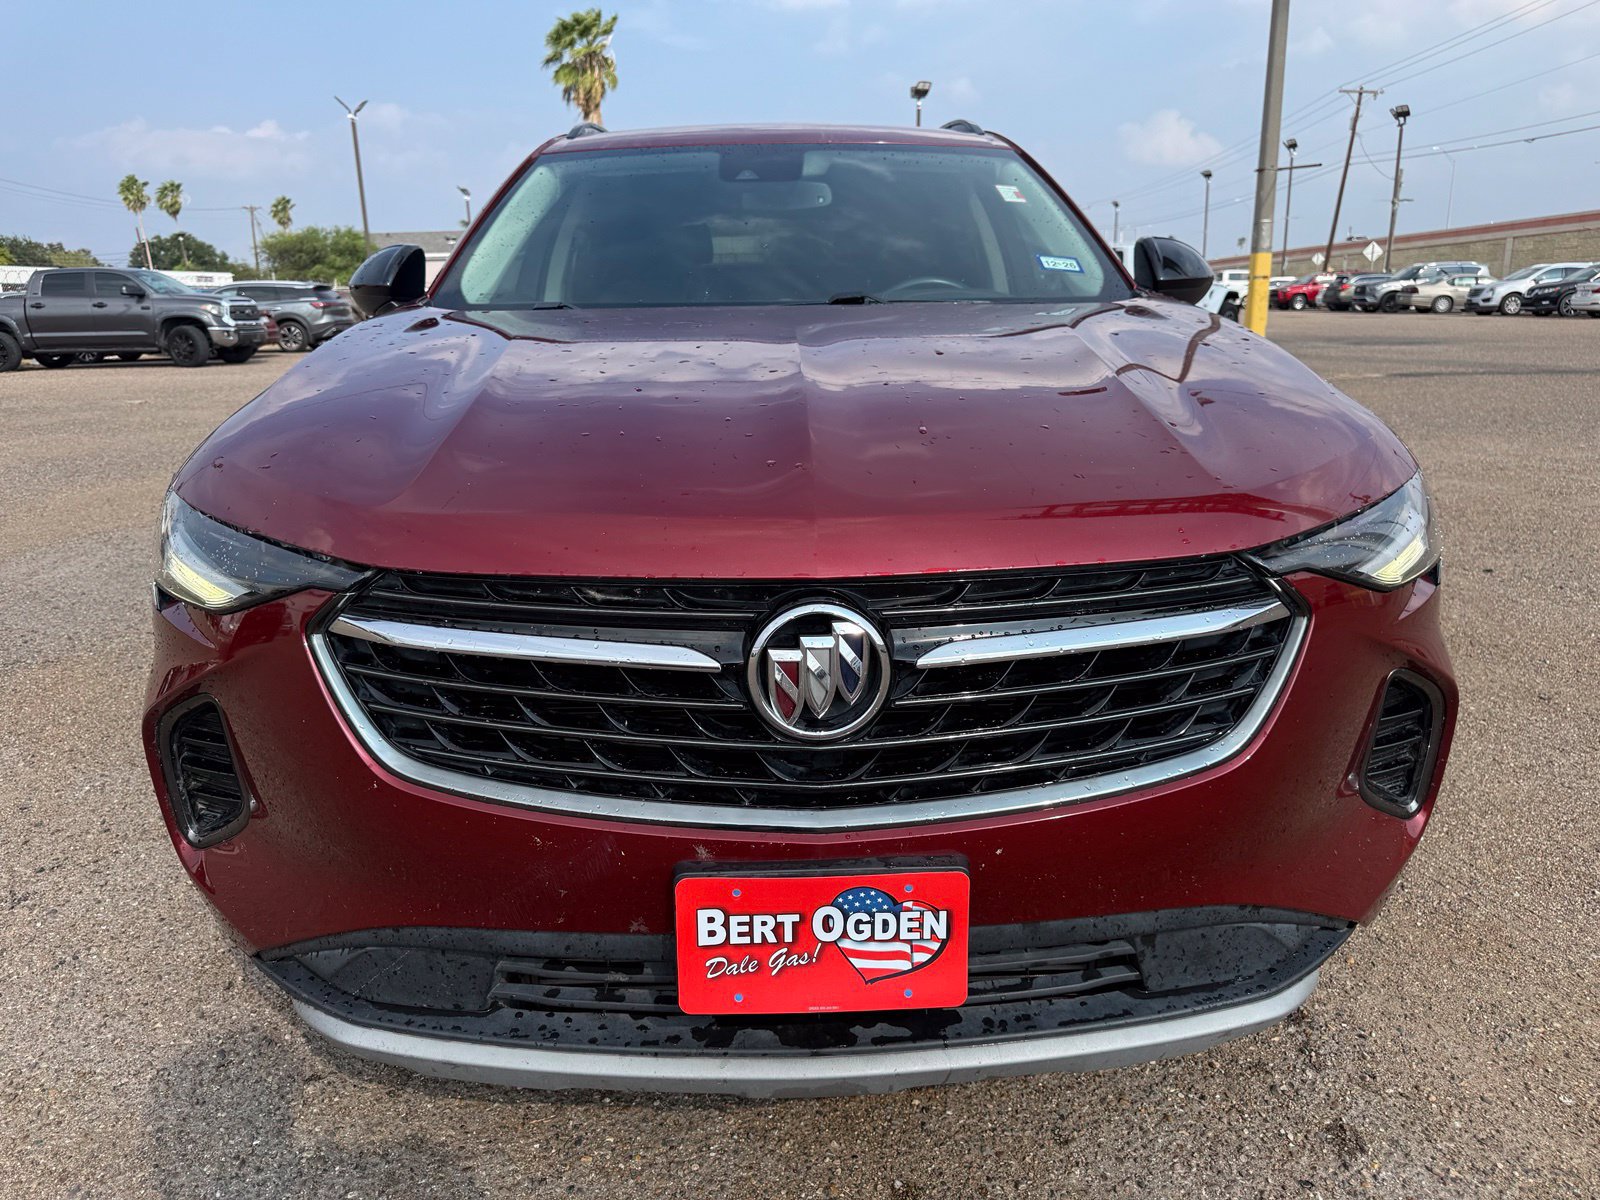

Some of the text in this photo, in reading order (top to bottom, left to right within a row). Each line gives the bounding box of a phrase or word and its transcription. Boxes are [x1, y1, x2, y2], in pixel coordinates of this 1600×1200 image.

[697, 906, 948, 946] BERT OGDEN
[705, 943, 822, 979] Dale Gas!
